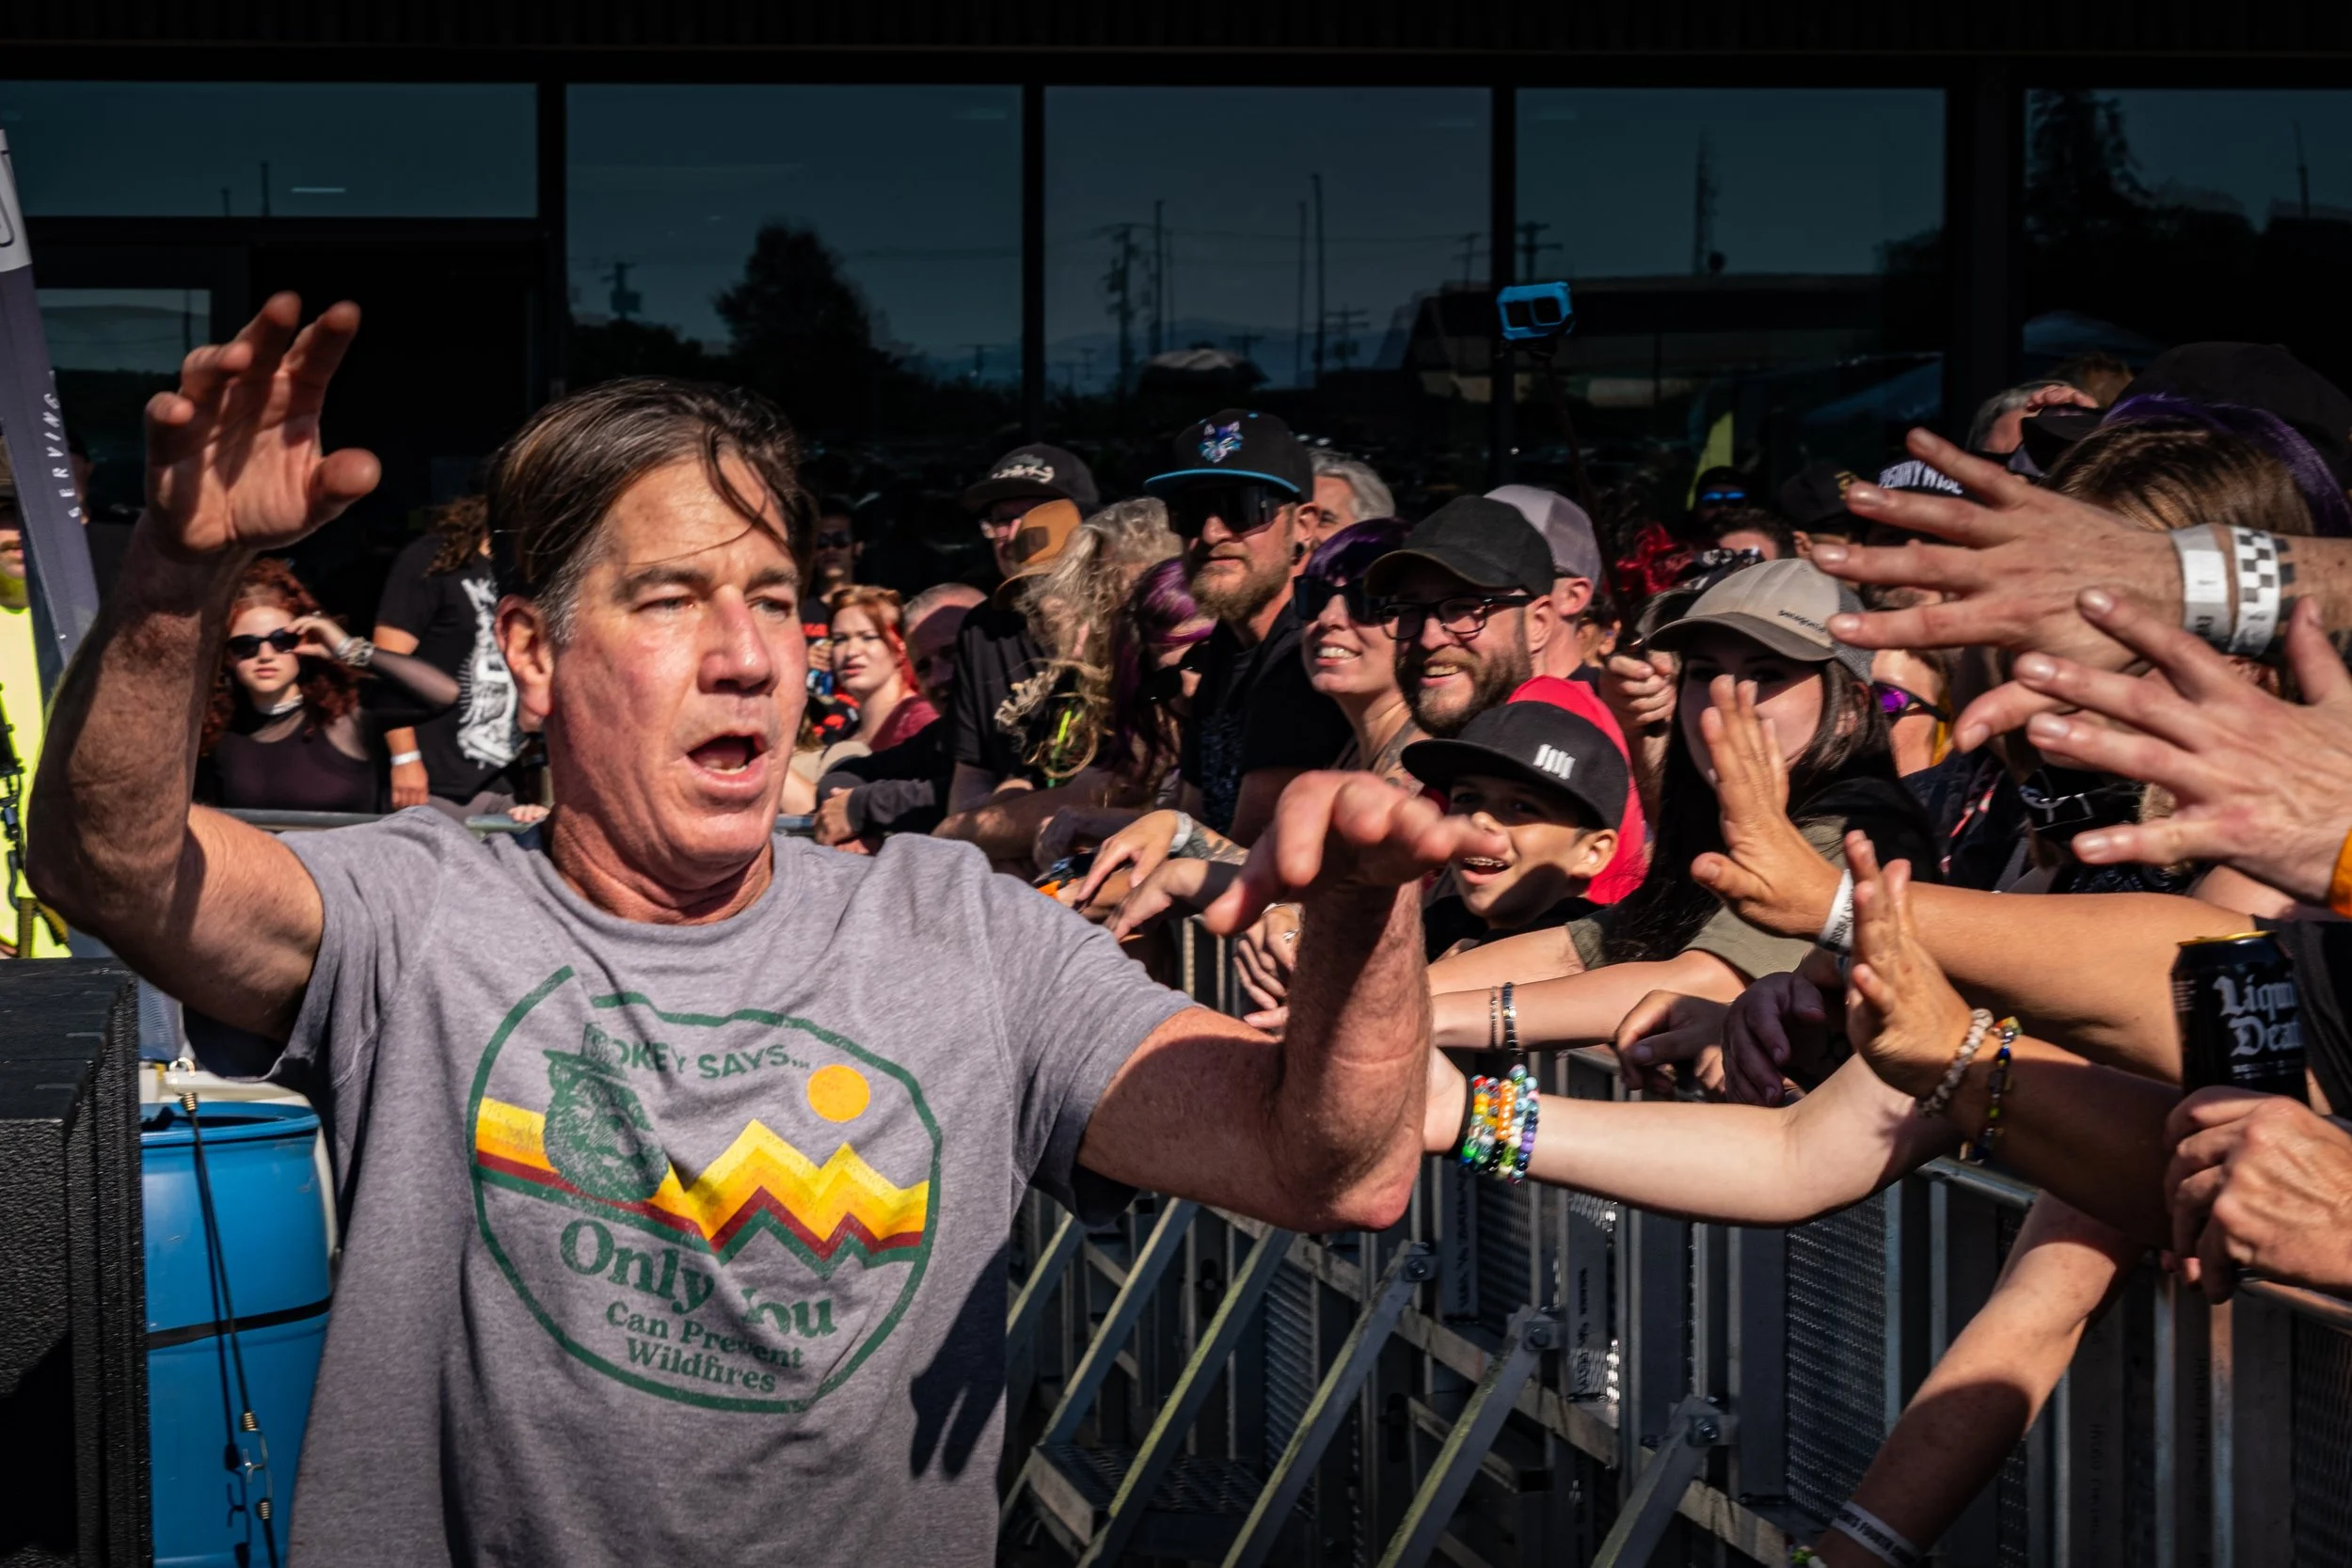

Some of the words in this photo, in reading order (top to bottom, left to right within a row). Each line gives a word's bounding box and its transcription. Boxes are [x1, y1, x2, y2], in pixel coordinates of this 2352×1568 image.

[560, 1218, 715, 1315] Only
[606, 1301, 669, 1339] Can
[680, 1320, 804, 1369] Prevent
[626, 1337, 776, 1393] Wildfires
